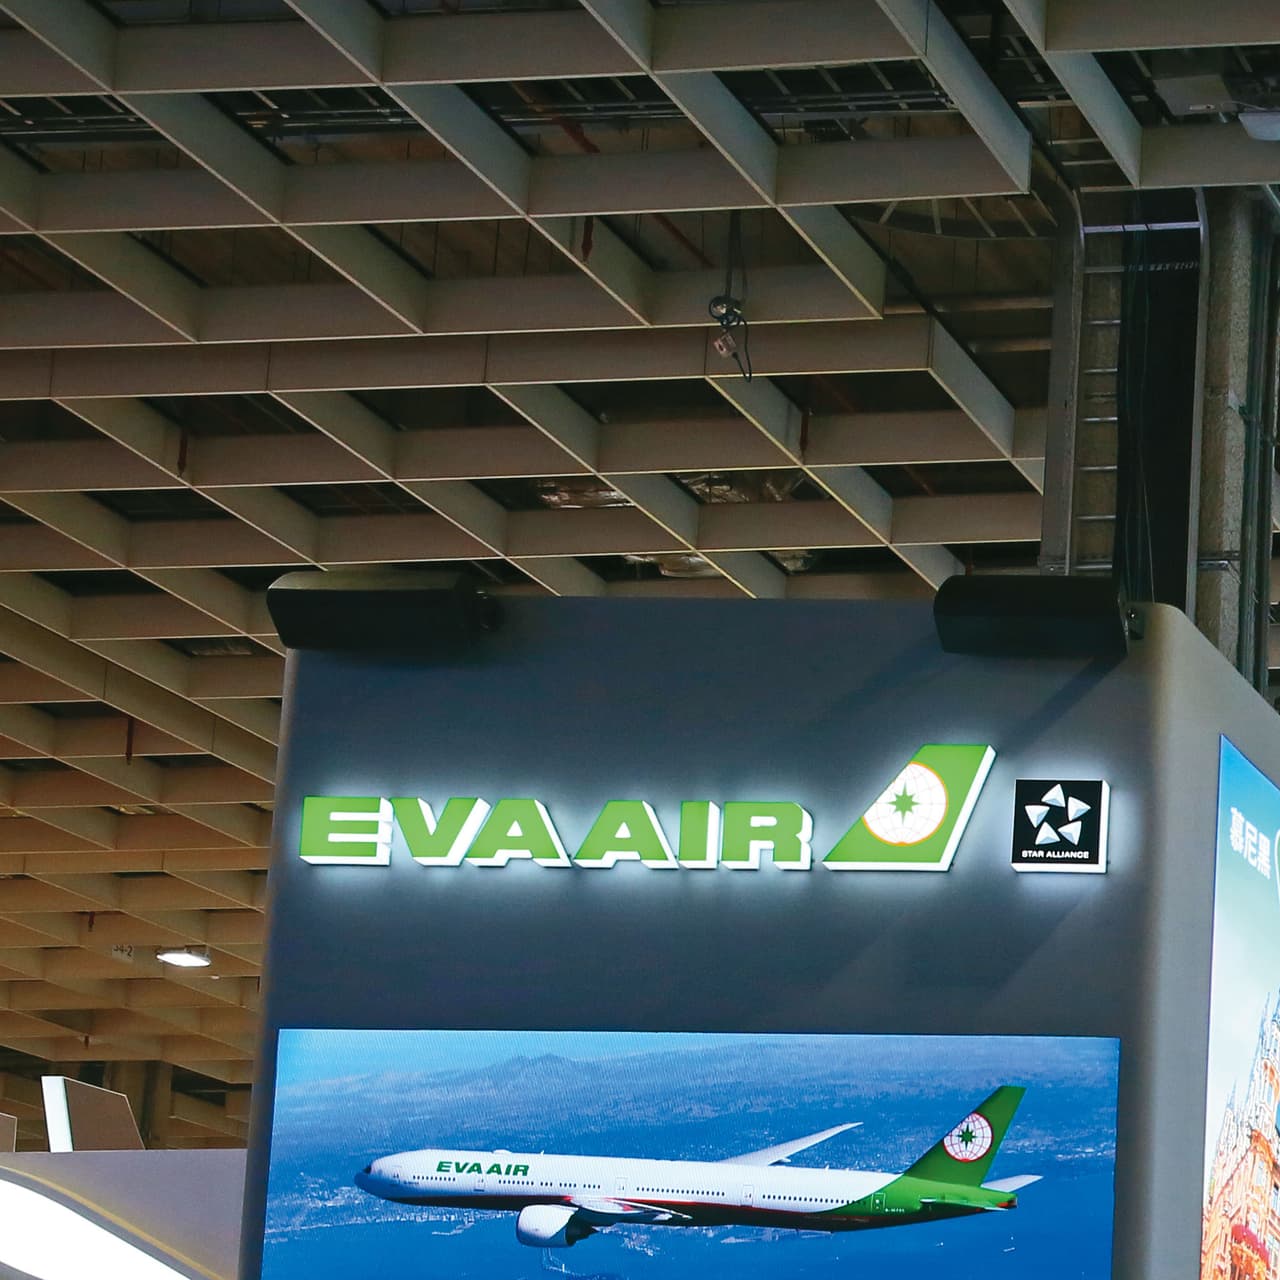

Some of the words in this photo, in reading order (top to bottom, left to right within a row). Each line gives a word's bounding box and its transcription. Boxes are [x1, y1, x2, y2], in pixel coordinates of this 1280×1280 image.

[1021, 850, 1044, 859] STAR
[1045, 850, 1090, 860] ALLIANCE
[1229, 806, 1272, 880] 慕尼黑
